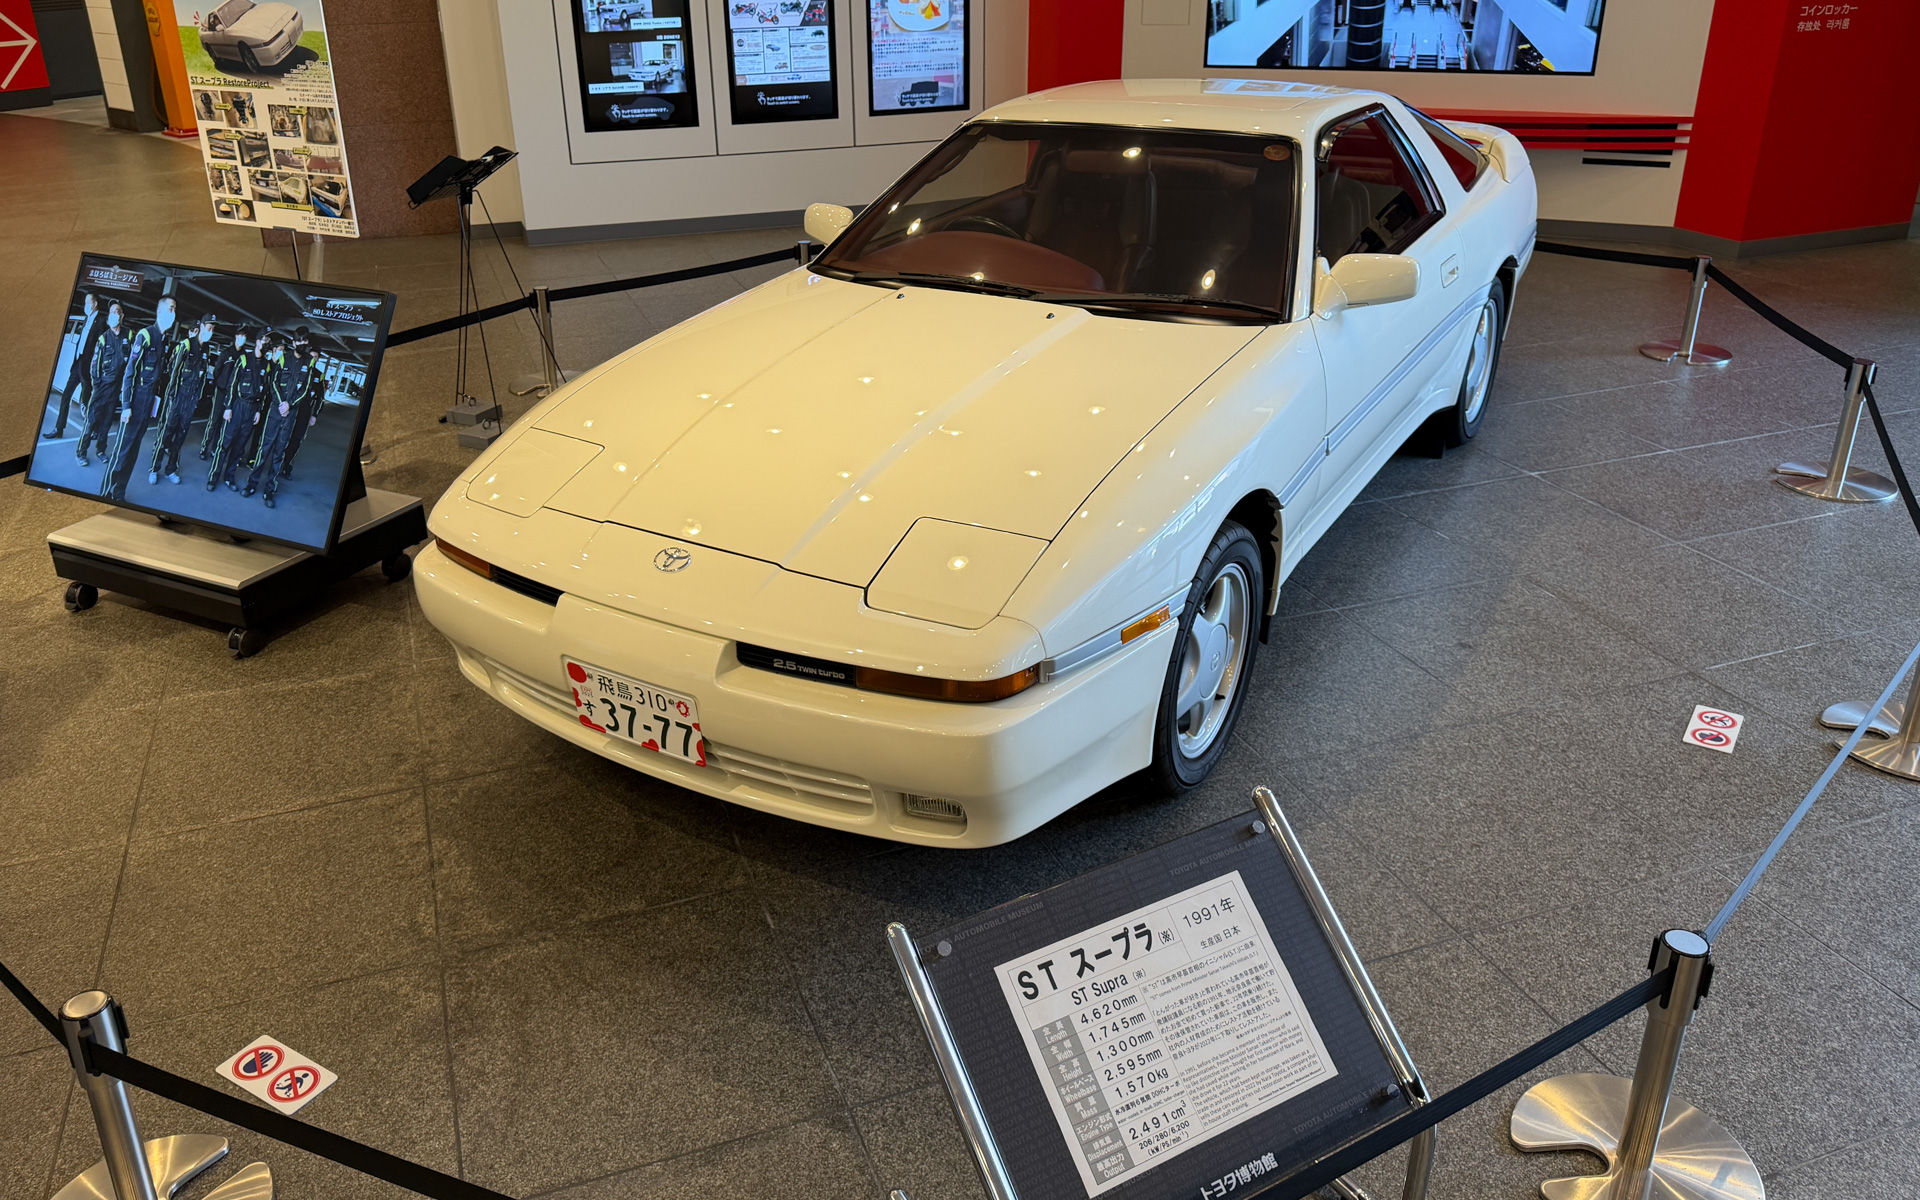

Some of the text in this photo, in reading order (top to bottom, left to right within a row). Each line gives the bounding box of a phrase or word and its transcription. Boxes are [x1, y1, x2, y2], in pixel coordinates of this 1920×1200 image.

[1800, 3, 1858, 16] コインロッカー
[223, 78, 270, 88] RestoreProject
[773, 658, 845, 680] 2.5 TWIN turbo
[600, 698, 693, 757] 37-77
[1008, 901, 1044, 921] MUSEUM
[1182, 897, 1235, 927] 1991年
[1200, 925, 1240, 949] 生産国 日本
[1017, 959, 1058, 1000] ST
[1069, 922, 1152, 978] スープラ
[1071, 986, 1088, 1005] ST
[1091, 974, 1128, 996] Supra
[1045, 1029, 1067, 1044] Length
[1055, 1049, 1073, 1061] Width
[1062, 1066, 1083, 1081] Height
[1063, 1084, 1096, 1103] Wheelbase
[1080, 1106, 1097, 1118] Mass
[1080, 1121, 1113, 1141] Engine Type
[1087, 1139, 1123, 1161] Displacement
[1103, 1162, 1125, 1177] Output
[1200, 1152, 1279, 1200] トヨタ博物館
